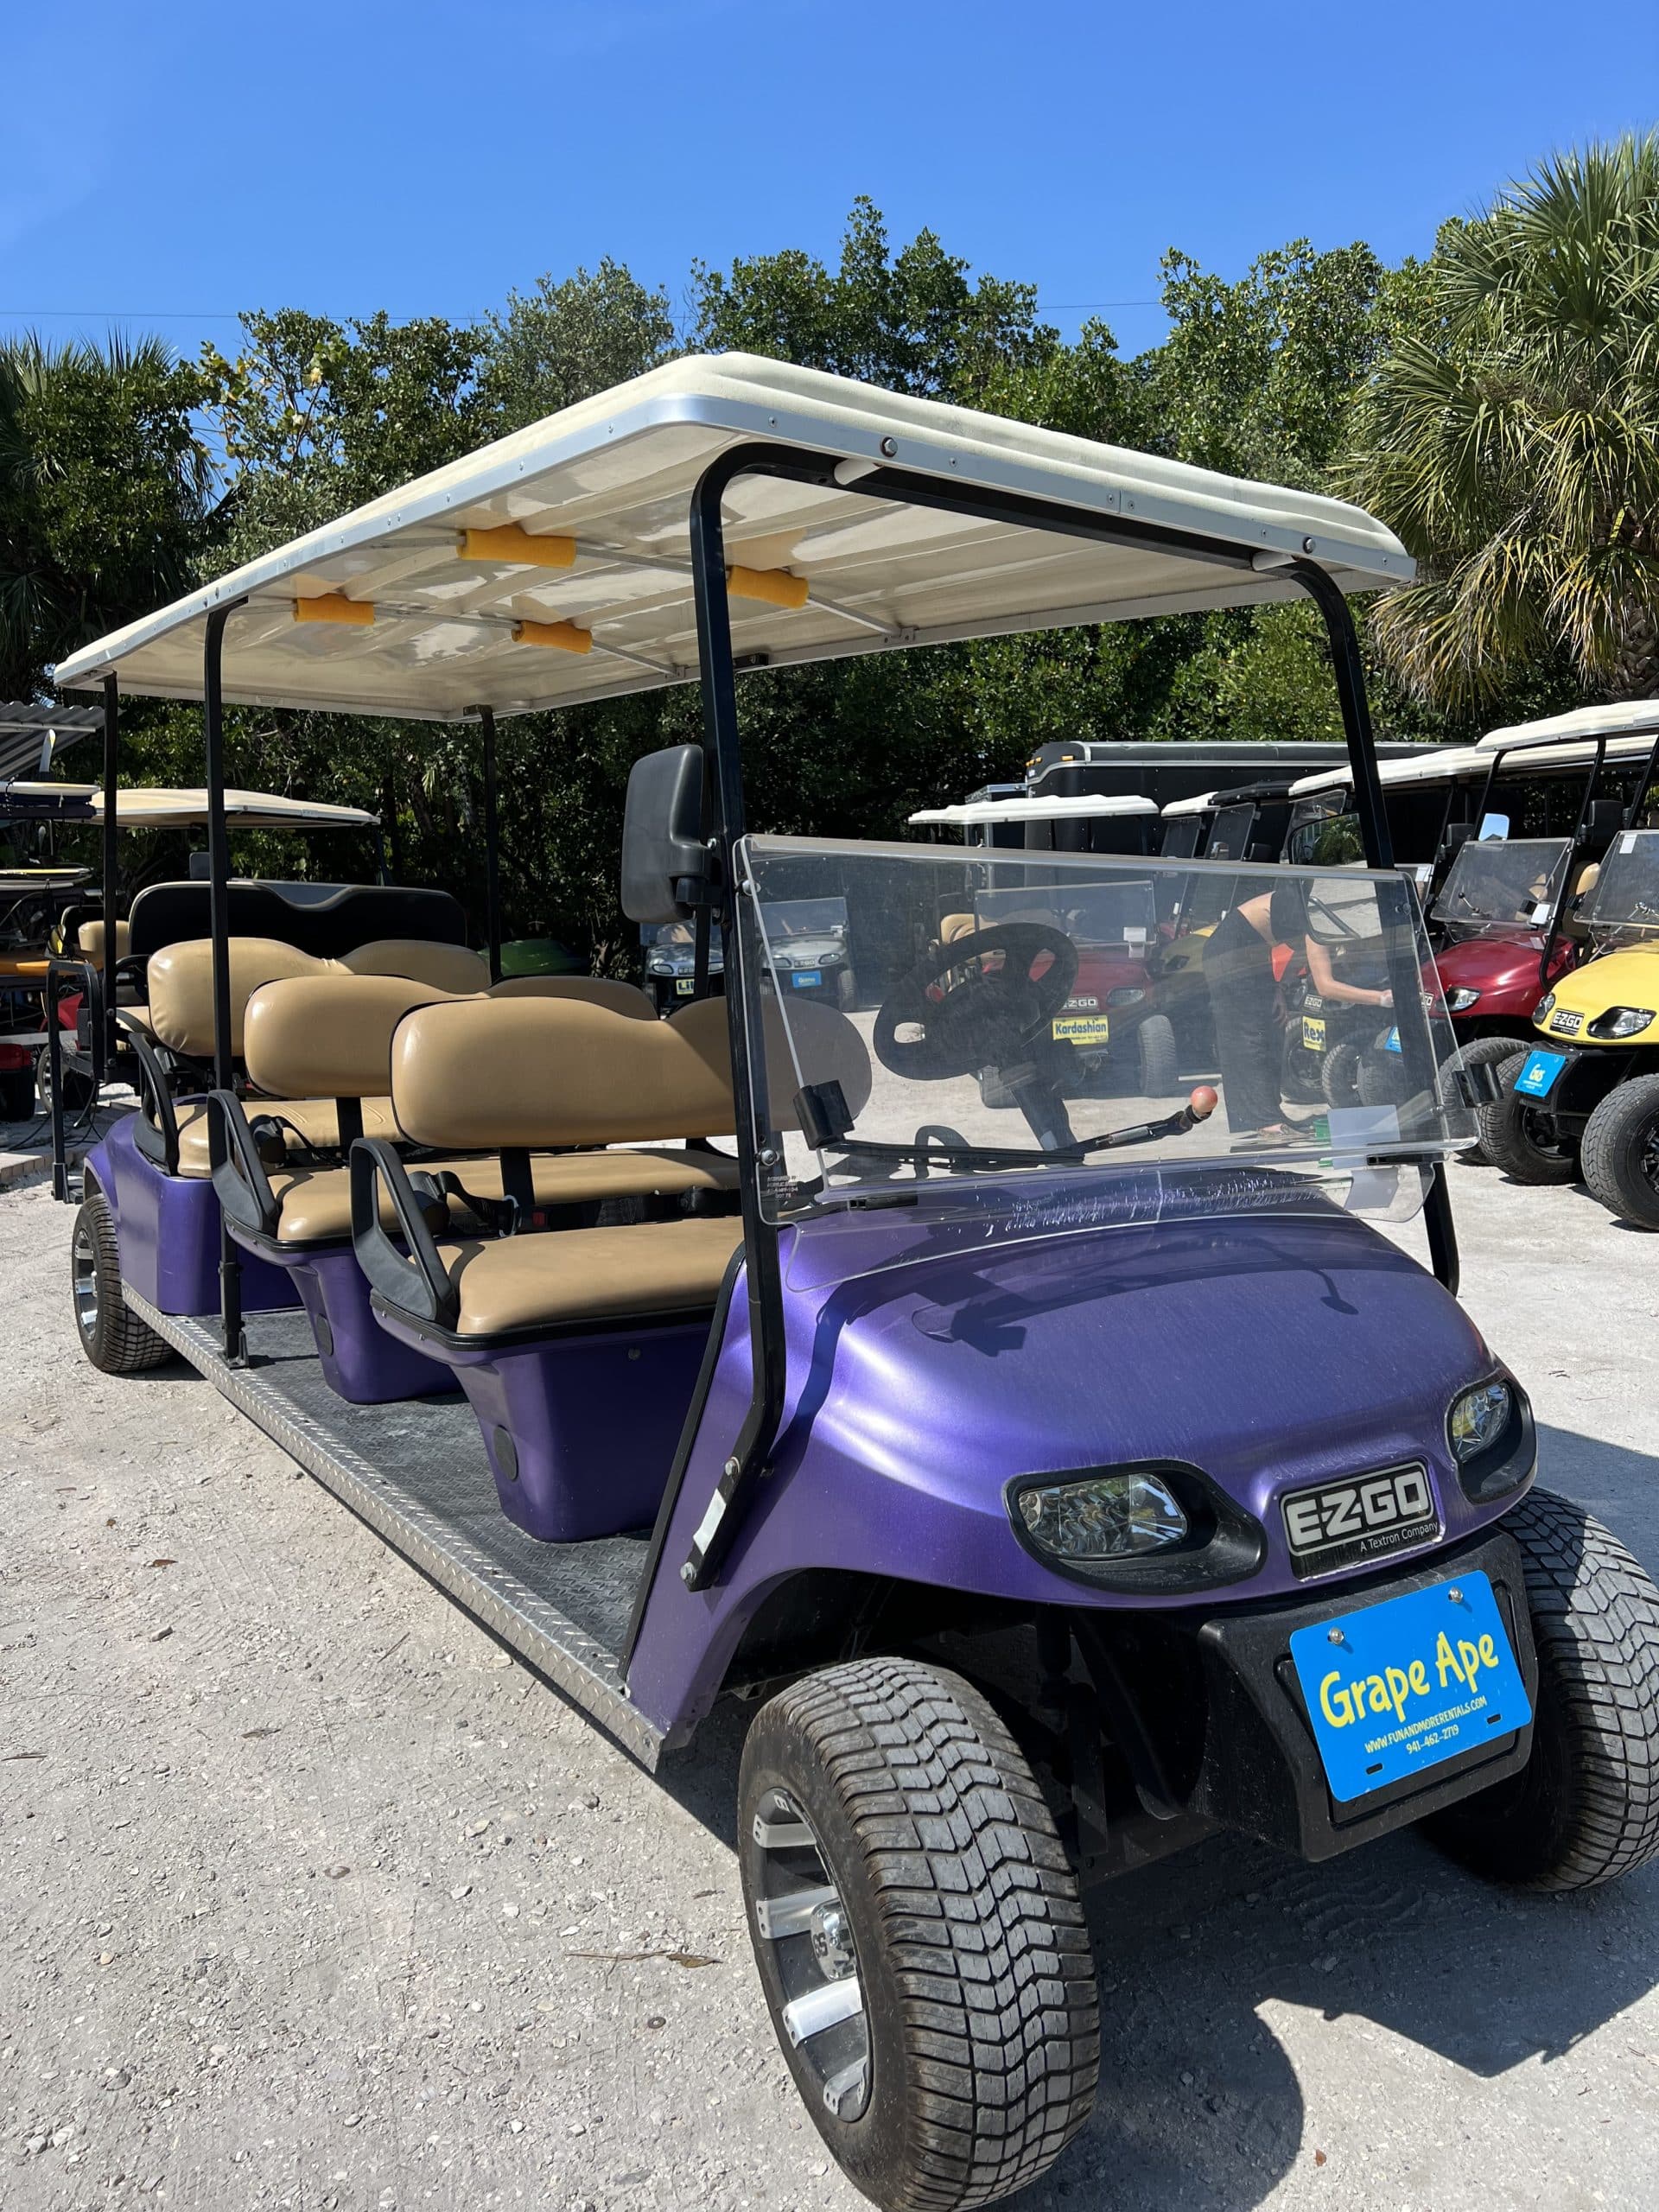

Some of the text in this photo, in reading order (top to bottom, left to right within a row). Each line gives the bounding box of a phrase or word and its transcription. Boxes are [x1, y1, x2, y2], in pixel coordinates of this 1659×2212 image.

[1064, 998, 1097, 1007] ZGO
[1056, 1020, 1106, 1034] Kardashian
[1304, 1022, 1325, 1042] Rex
[1553, 1013, 1583, 1028] EZGO
[1360, 1522, 1438, 1553] A Textron Company
[1319, 1631, 1500, 1728] Grape Ape
[1364, 1695, 1488, 1754] WWW.FUNANDMORERENTALS.COM
[1406, 1724, 1459, 1755] 941-462-2719
